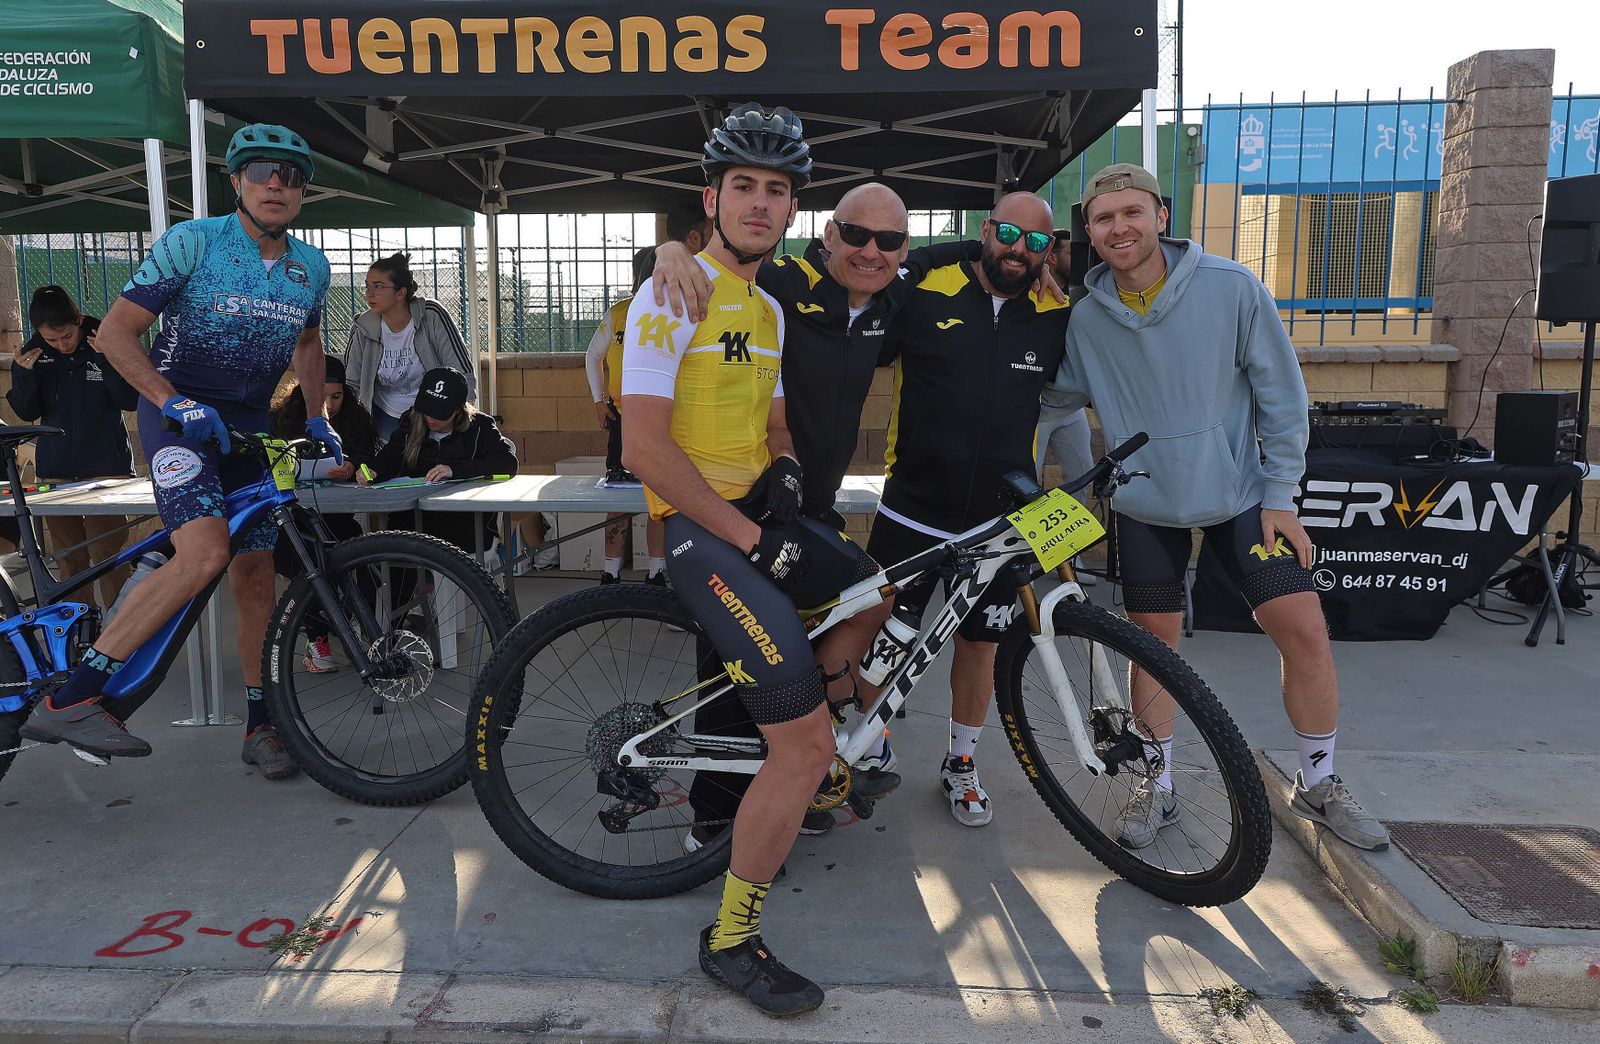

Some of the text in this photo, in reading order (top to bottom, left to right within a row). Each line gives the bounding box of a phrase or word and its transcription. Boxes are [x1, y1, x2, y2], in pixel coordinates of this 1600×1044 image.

[824, 8, 1082, 71] Team
[0, 82, 94, 96] DE CICLISMO
[252, 298, 307, 318] CANTERAS
[271, 312, 305, 327] ANTONIO
[425, 389, 449, 400] SCOTT
[182, 408, 206, 423] FOX
[1292, 479, 1539, 535] ERVAN
[1039, 508, 1069, 533] 253
[671, 539, 694, 558] FASTER
[770, 540, 793, 576] 100%
[1318, 546, 1469, 571] juanmaservan_dj
[1342, 573, 1448, 593] 644 87 45 91
[867, 564, 992, 726] TREK
[476, 695, 493, 772] MAXXIS
[1005, 713, 1039, 778] MAXXIS
